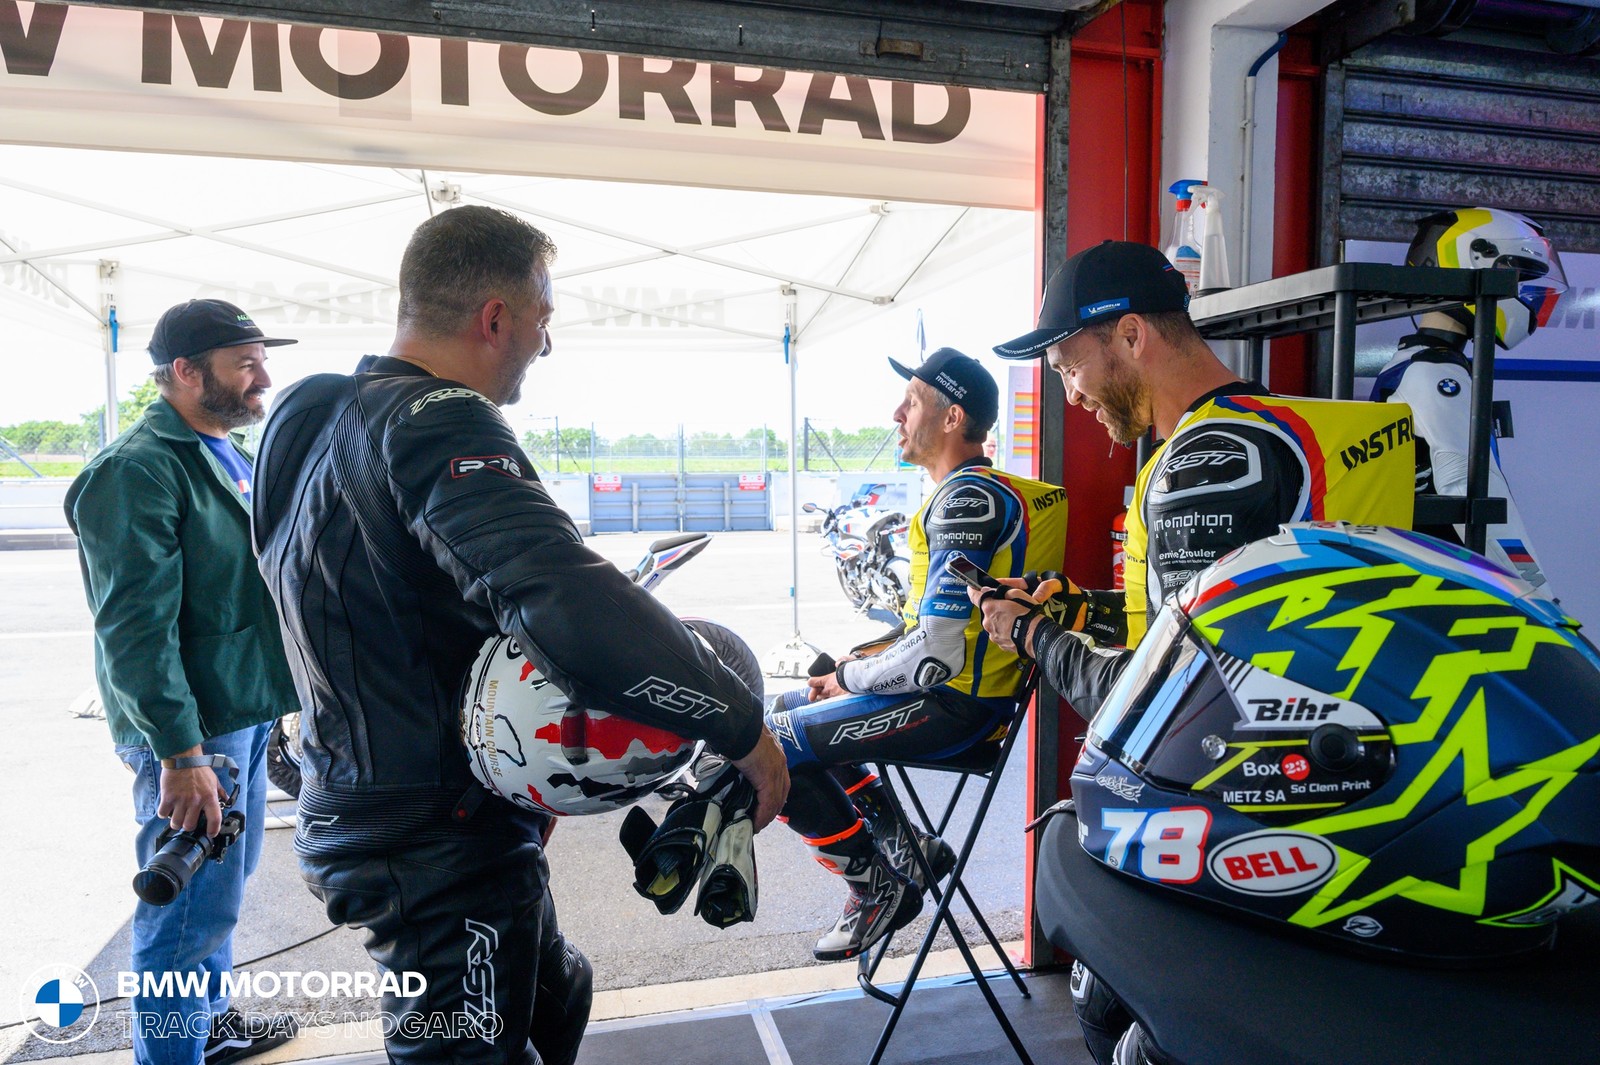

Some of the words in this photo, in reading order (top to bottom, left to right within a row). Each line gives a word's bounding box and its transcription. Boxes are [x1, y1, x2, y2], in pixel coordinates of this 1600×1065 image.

[1034, 337, 1053, 349] TRACK
[1053, 330, 1069, 341] DAYS
[935, 375, 964, 400] motards
[1155, 450, 1247, 484] RST
[938, 497, 990, 513] RST
[931, 601, 967, 612] Bihr
[485, 679, 499, 738] MOUNTAIN
[622, 675, 730, 720] RST
[1247, 697, 1340, 722] Bihr
[828, 699, 926, 746] RST
[485, 740, 502, 778] COURSE
[1242, 761, 1282, 777] Box
[1284, 759, 1308, 775] 23
[1223, 790, 1262, 803] METZ
[1264, 789, 1286, 803] SA
[1308, 782, 1339, 794] Clem
[1341, 779, 1372, 791] Print
[1101, 805, 1213, 885] 78
[1223, 846, 1318, 881] BELL
